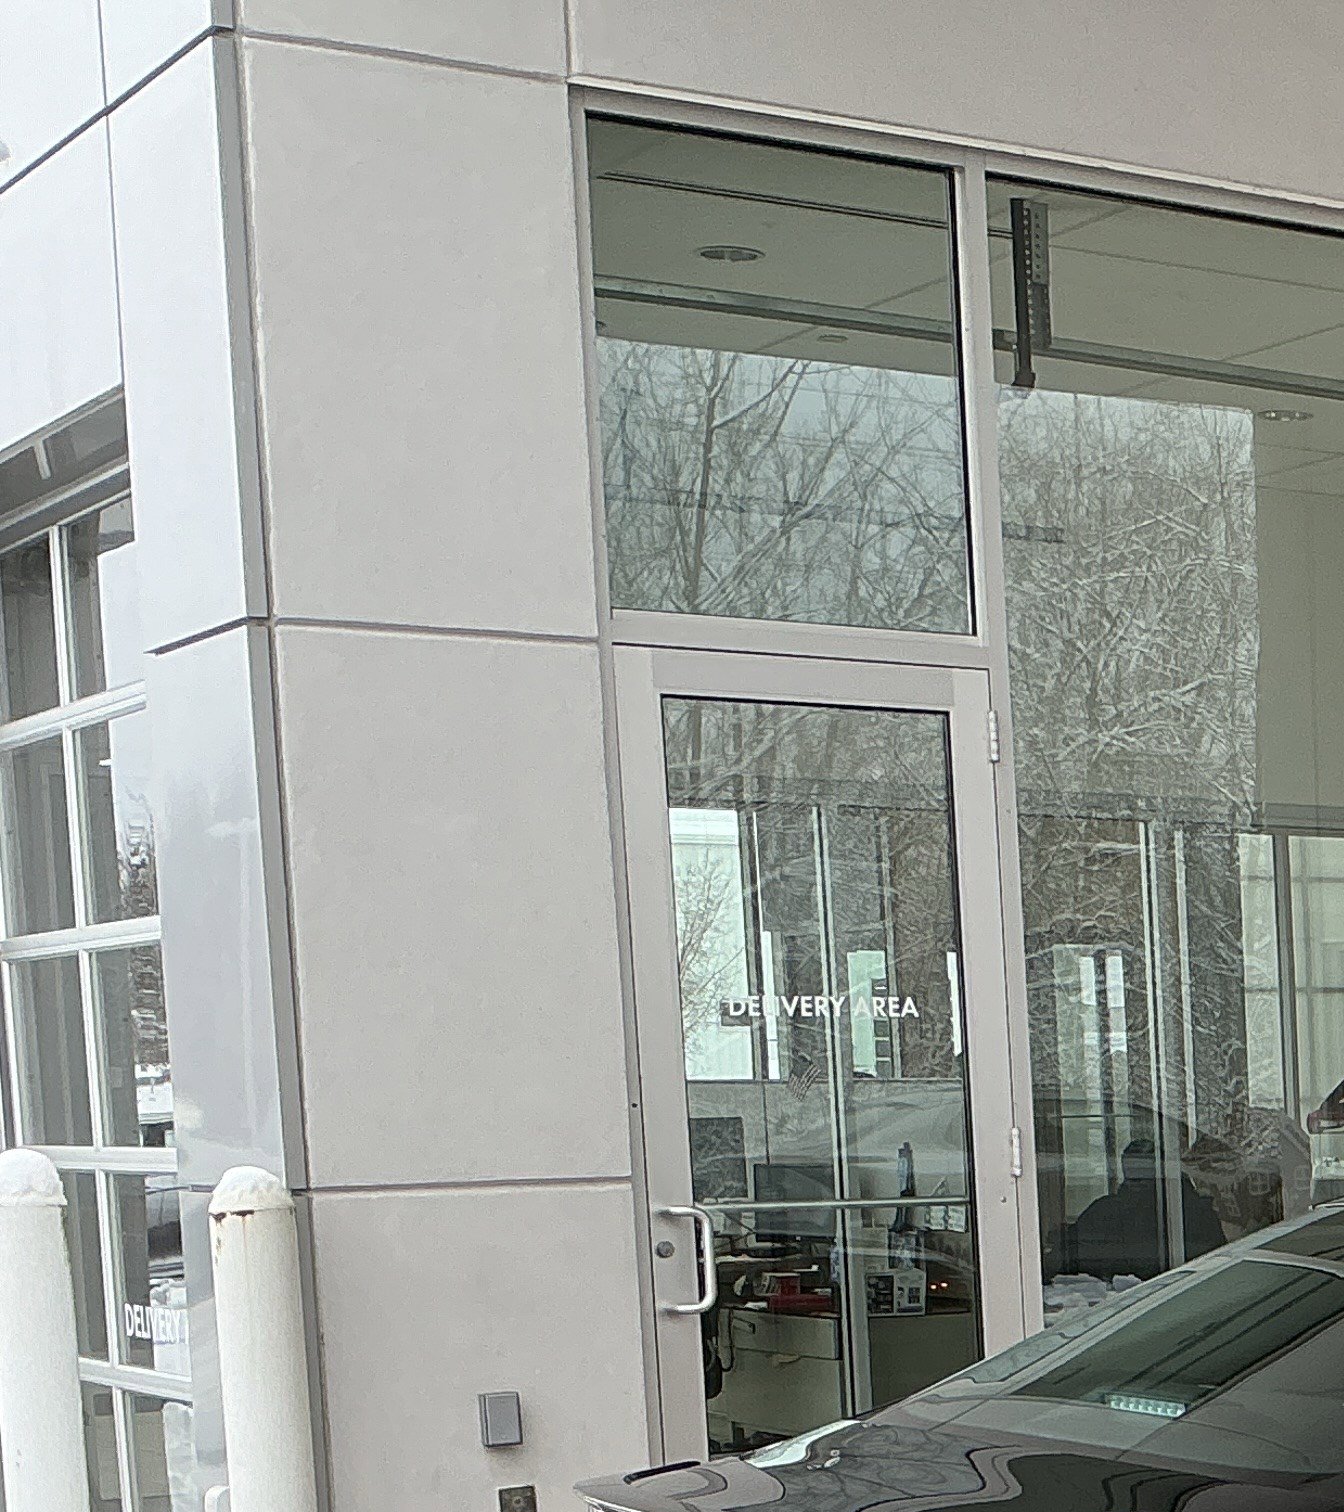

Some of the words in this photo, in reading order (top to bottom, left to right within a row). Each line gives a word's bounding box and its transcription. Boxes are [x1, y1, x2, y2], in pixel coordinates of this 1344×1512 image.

[729, 995, 846, 1018] DELIVERY
[854, 996, 919, 1018] AREA
[124, 1302, 181, 1344] DELIVERY
